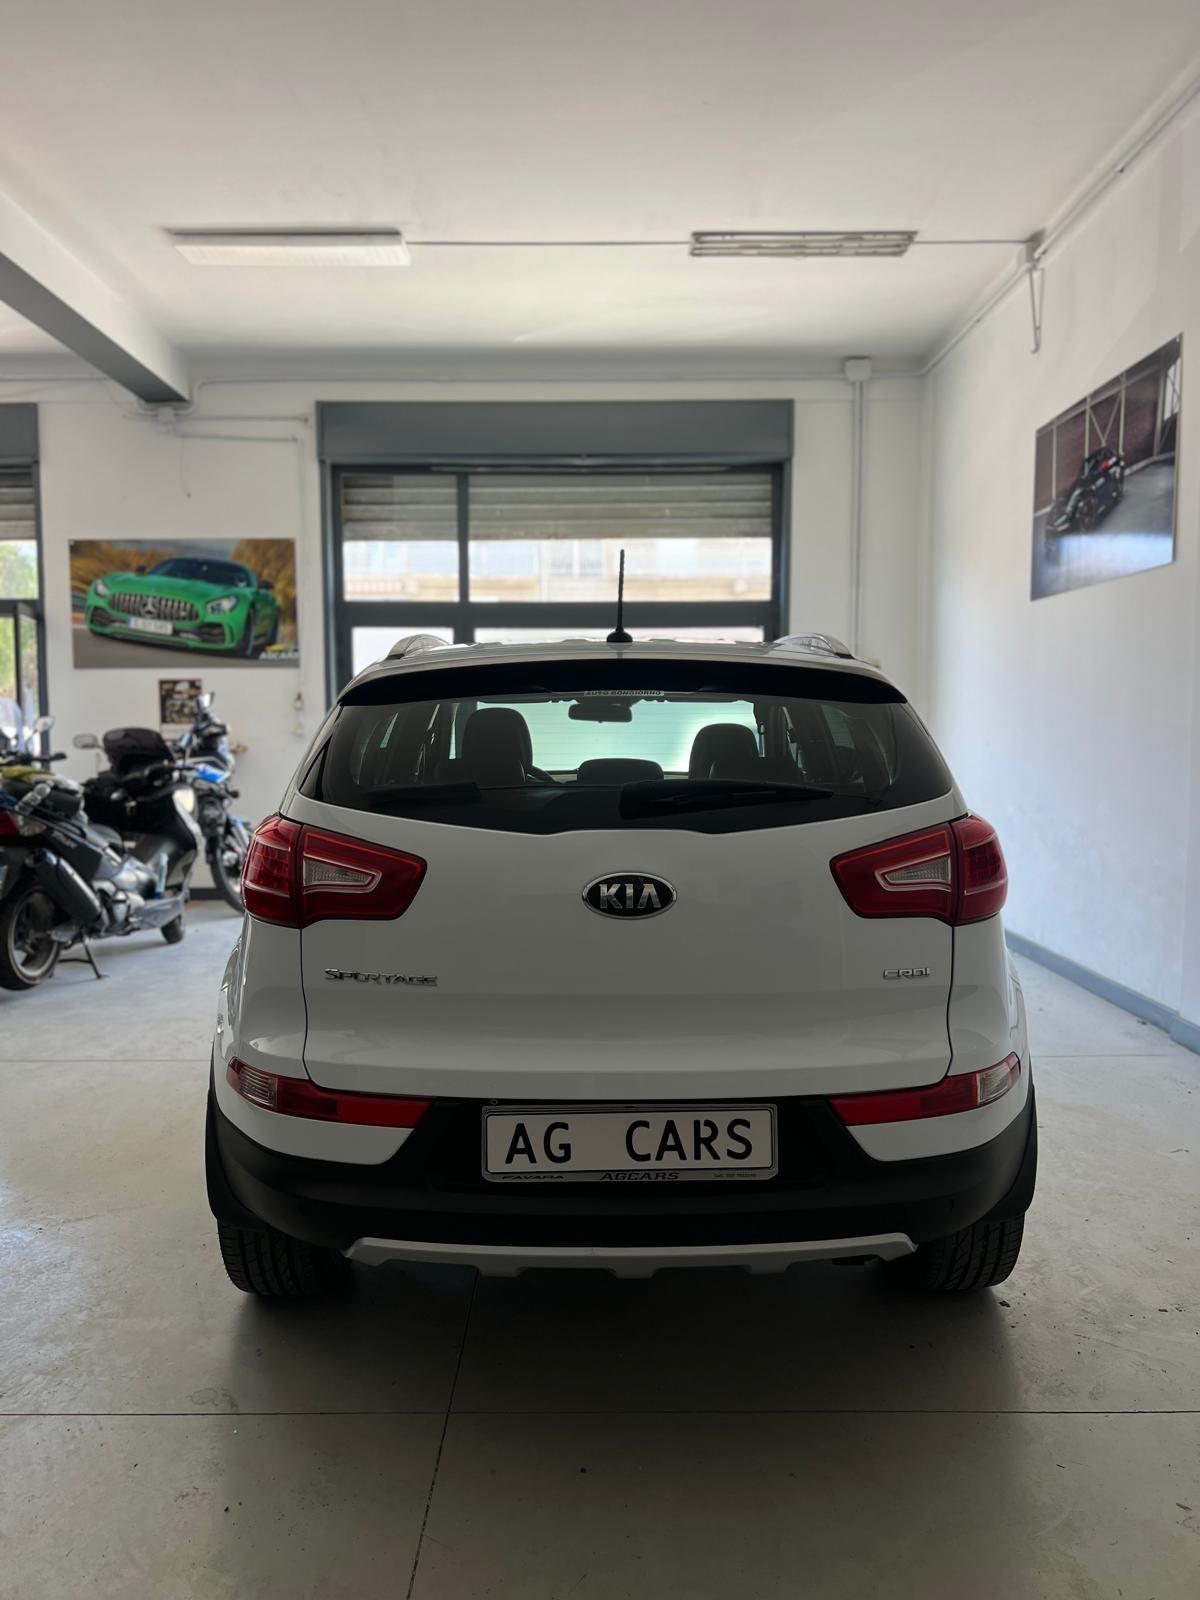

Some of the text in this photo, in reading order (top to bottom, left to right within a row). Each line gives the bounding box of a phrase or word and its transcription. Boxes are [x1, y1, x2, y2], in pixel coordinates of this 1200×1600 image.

[599, 883, 662, 909] KIA
[325, 968, 438, 987] SPORTAGE
[504, 1118, 754, 1165] AG CARS
[599, 1171, 681, 1182] AGCARS
